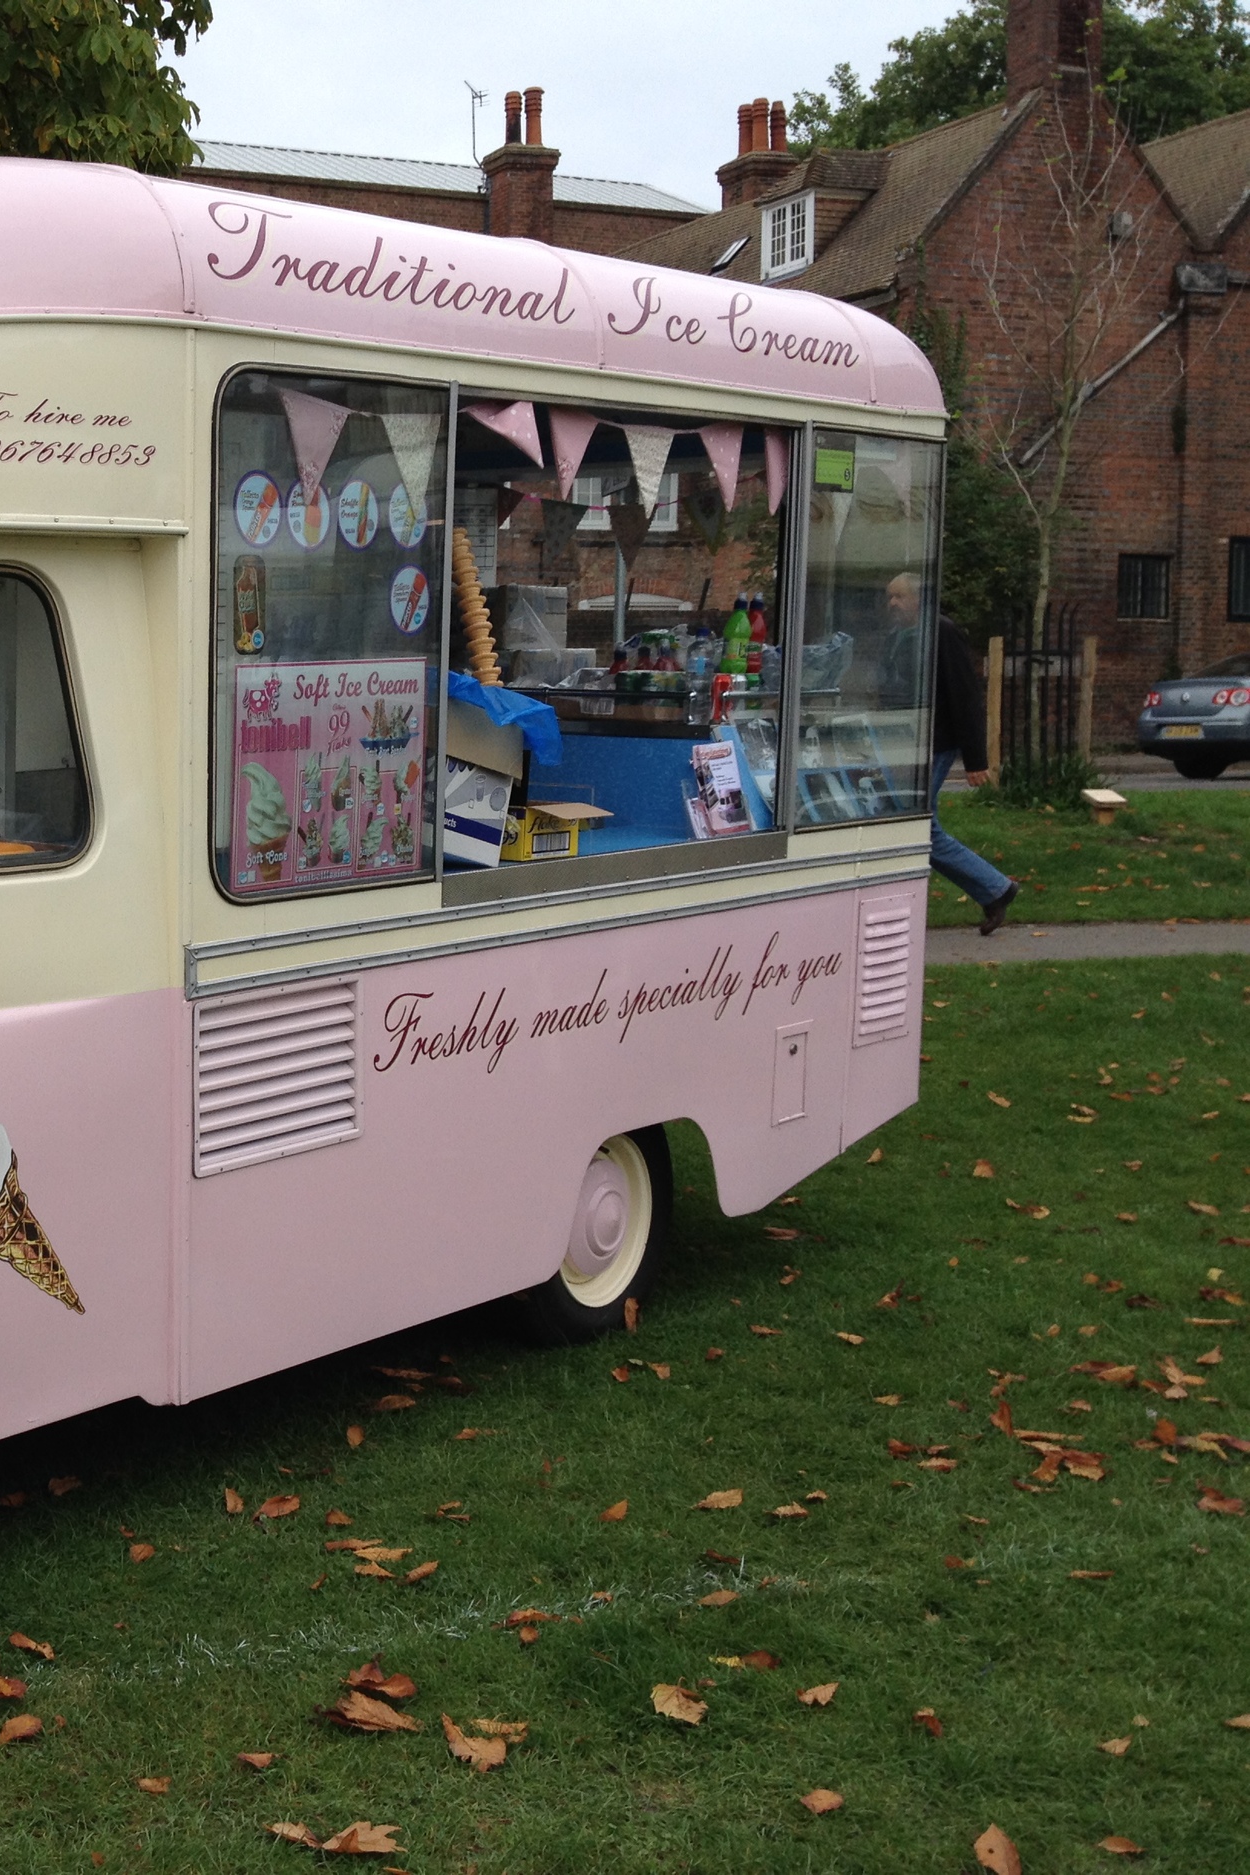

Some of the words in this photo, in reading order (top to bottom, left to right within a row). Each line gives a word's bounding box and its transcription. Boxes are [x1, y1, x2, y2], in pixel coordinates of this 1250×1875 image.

[207, 201, 576, 325] Traditional
[607, 276, 707, 345] Ice
[717, 292, 860, 368] Cream
[23, 398, 85, 425] hire
[91, 412, 133, 427] me
[293, 674, 330, 707] Soft
[335, 672, 362, 698] Ice
[367, 671, 419, 696] Cream
[240, 715, 312, 754] tonibell
[328, 710, 350, 737] 99
[373, 987, 520, 1074] Freshly
[530, 968, 610, 1038] made
[618, 943, 743, 1043] specially
[742, 930, 790, 1016] for
[791, 952, 844, 1005] you
